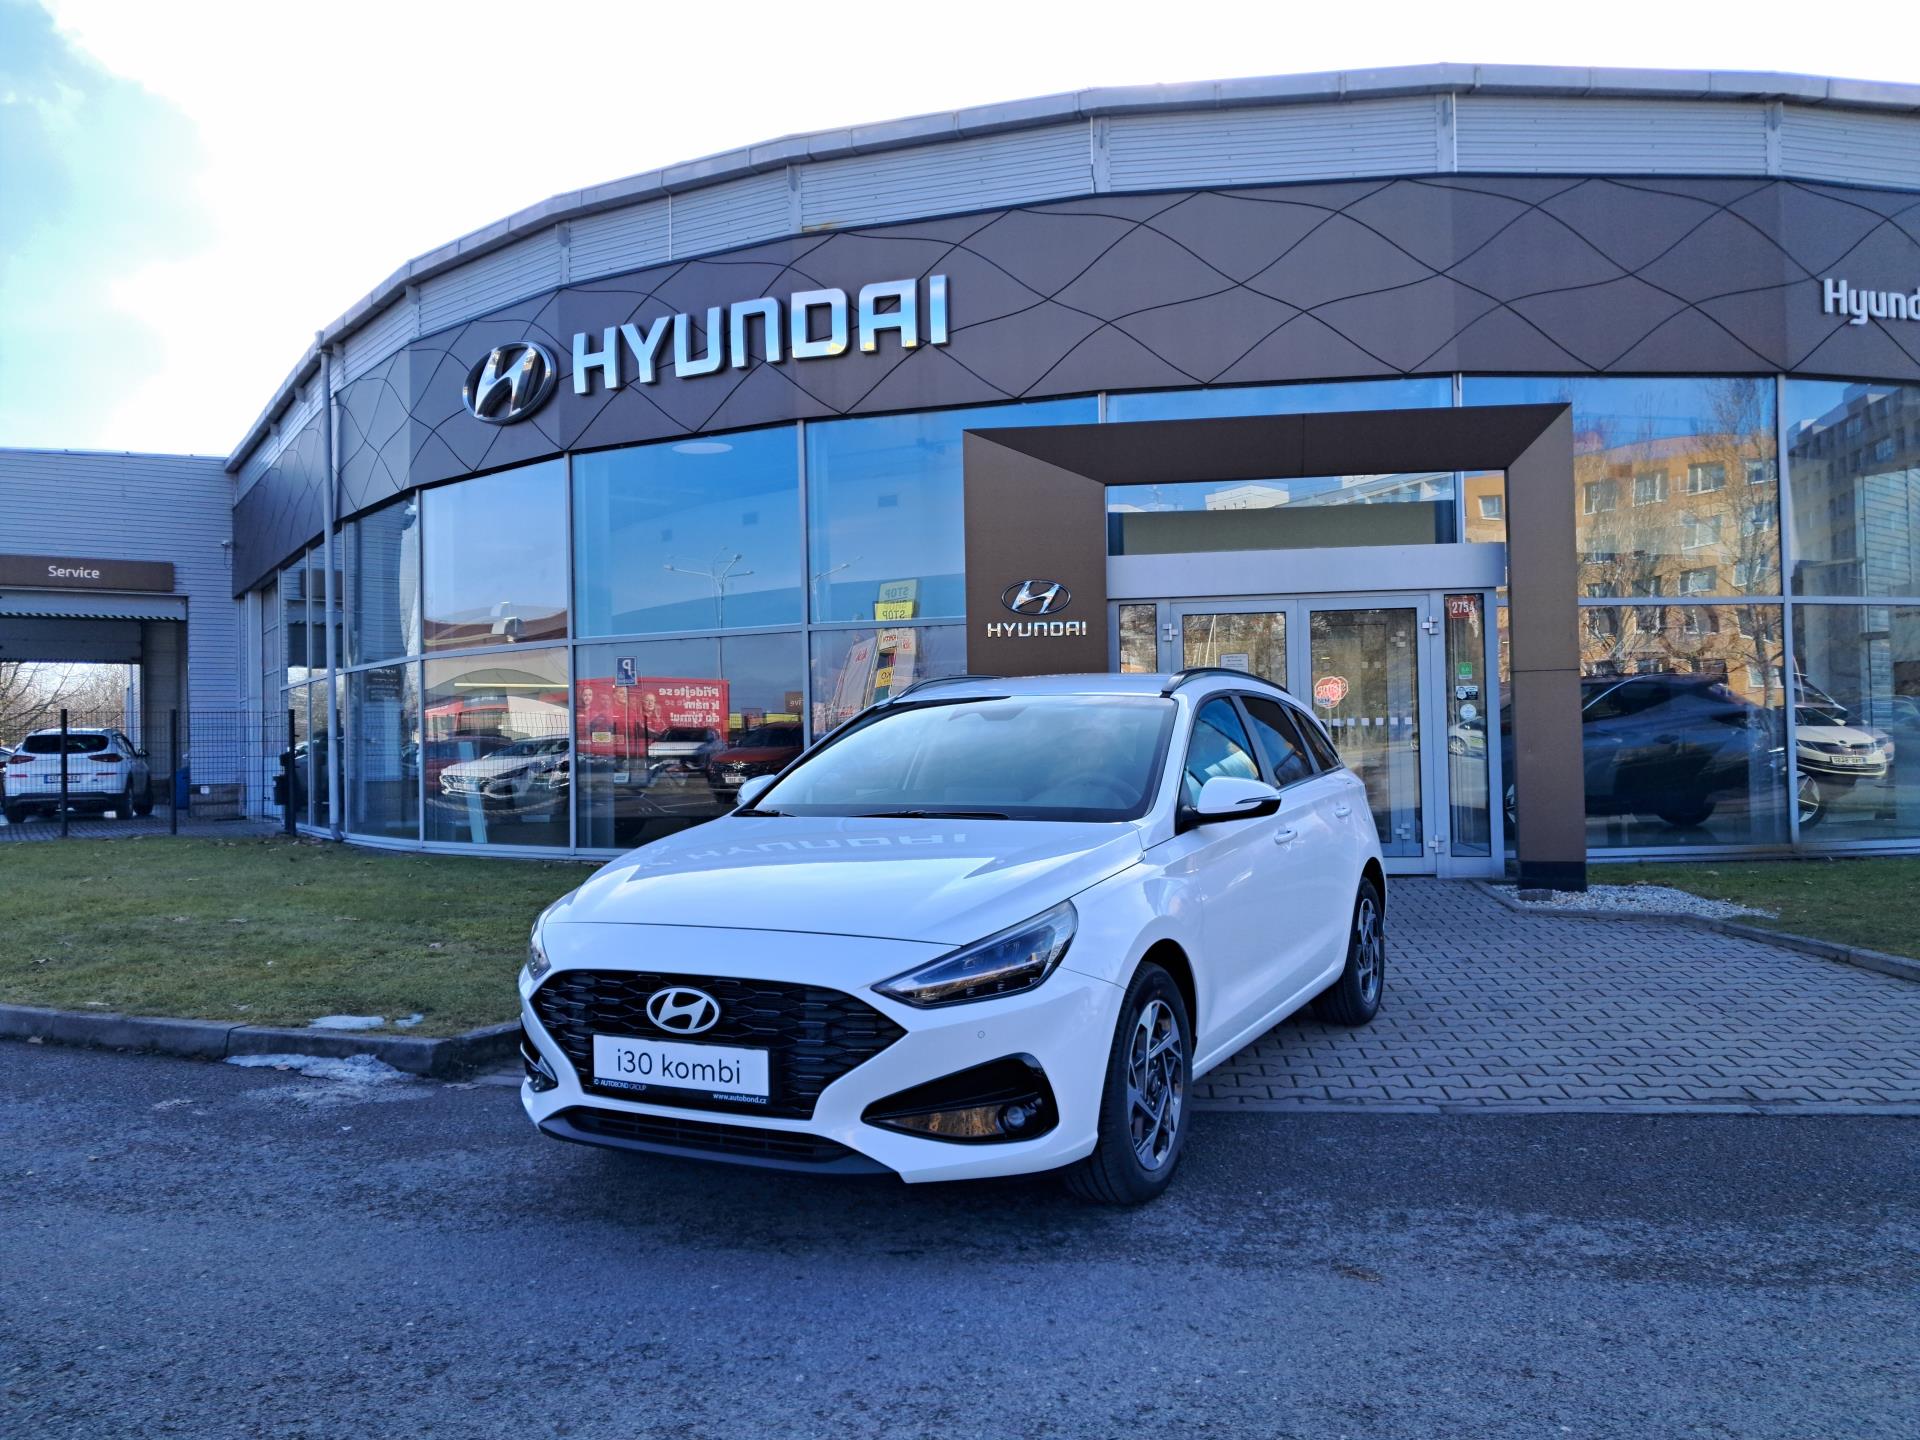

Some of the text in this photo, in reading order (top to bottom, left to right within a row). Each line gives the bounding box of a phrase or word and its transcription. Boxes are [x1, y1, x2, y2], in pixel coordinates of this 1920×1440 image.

[572, 273, 949, 395] HYUNDAI
[47, 565, 100, 579] Service
[1452, 601, 1476, 614] 2754
[987, 621, 1087, 637] HYUNDAI
[617, 1048, 741, 1085] i30 kombi
[600, 1079, 647, 1091] AUTOBOND GROUP
[712, 1092, 767, 1105] www.autobond.cz
